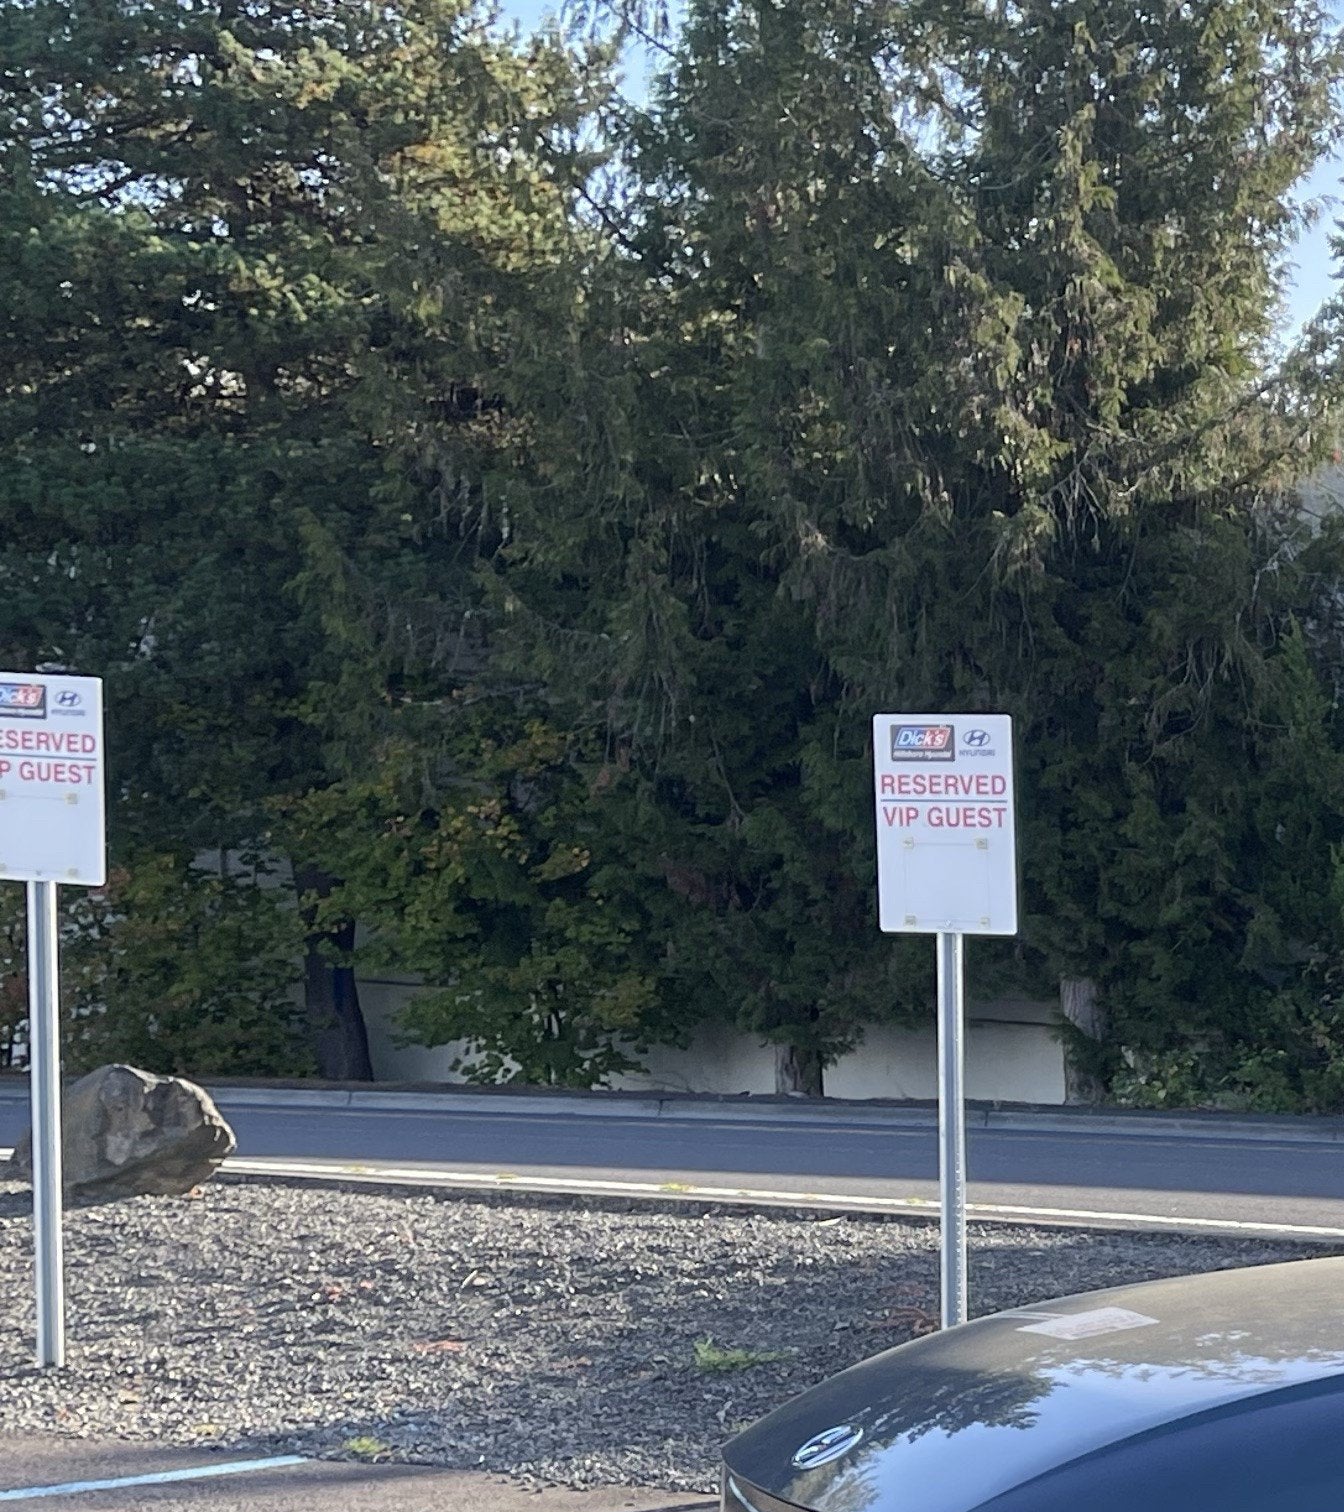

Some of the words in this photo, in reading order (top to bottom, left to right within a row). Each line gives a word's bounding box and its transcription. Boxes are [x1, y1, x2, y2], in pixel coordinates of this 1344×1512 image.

[19, 762, 96, 785] GUEST
[880, 774, 1007, 795] RESERVED
[883, 806, 919, 827] VIP
[927, 806, 1008, 828] GUEST
